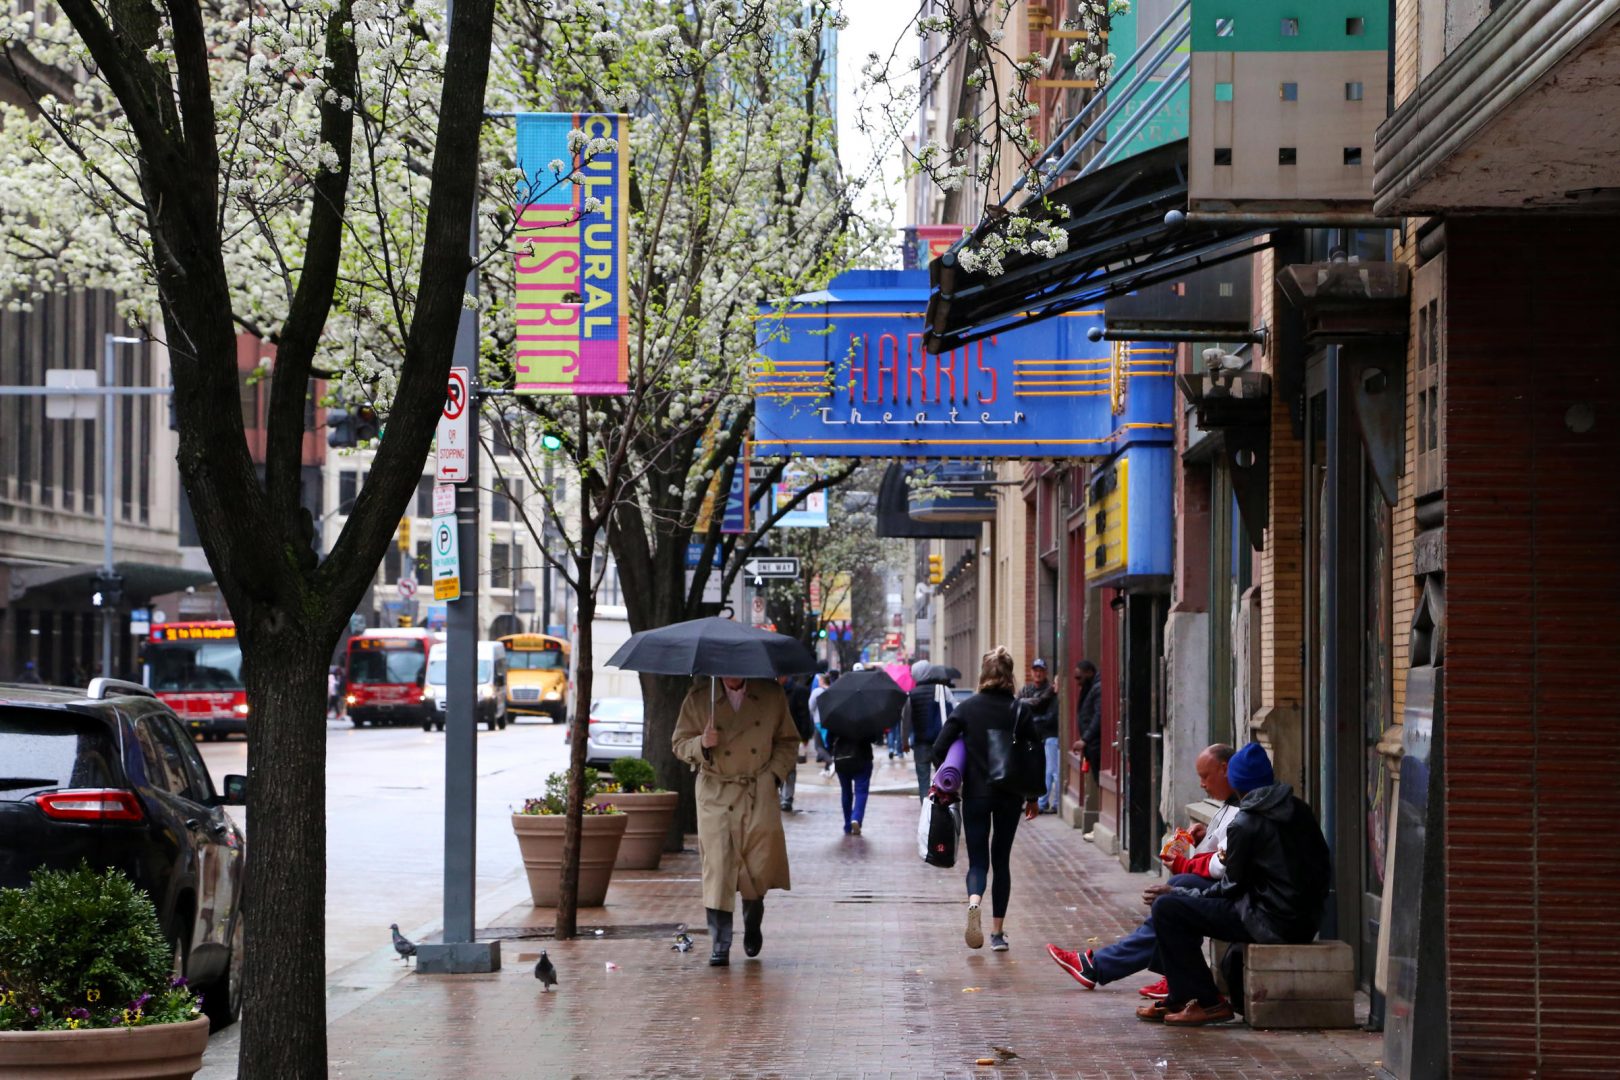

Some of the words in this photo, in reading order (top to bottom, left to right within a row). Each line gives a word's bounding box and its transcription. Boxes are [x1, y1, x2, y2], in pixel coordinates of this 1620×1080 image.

[584, 115, 612, 338] CULTURAL
[515, 204, 581, 382] DISTRIC
[849, 332, 998, 405] HARRIS
[818, 405, 1025, 425] Theater
[448, 429, 456, 440] OR
[440, 448, 465, 460] STOPPING
[753, 466, 773, 478] WA
[775, 563, 791, 571] WAY
